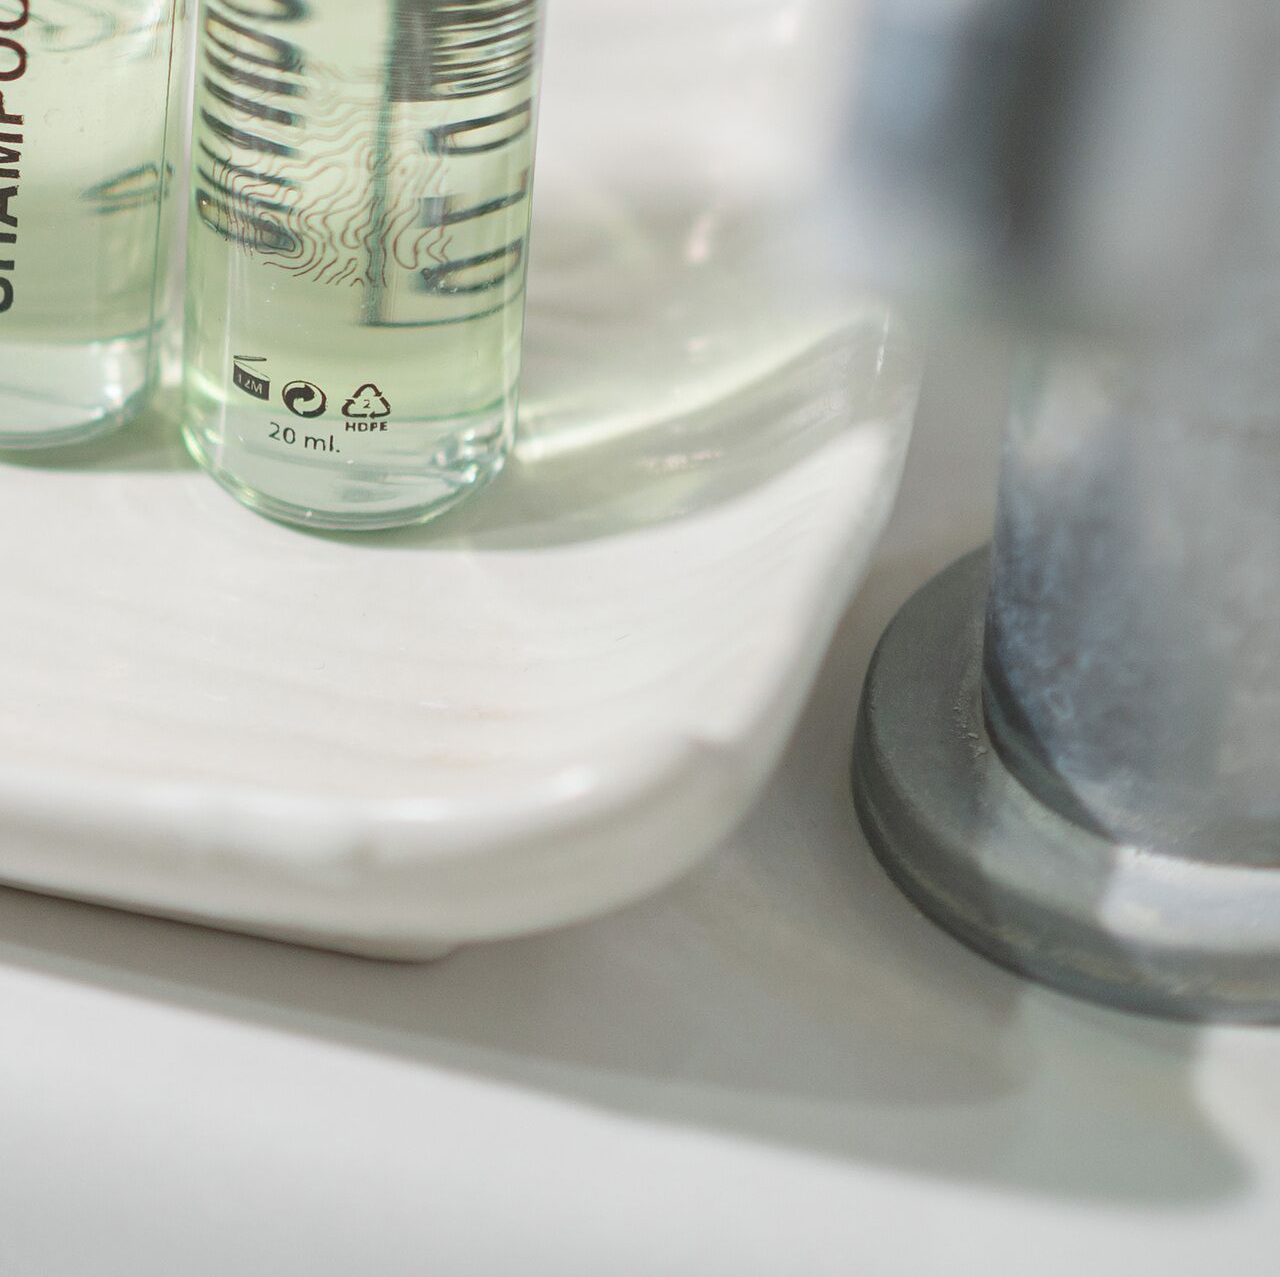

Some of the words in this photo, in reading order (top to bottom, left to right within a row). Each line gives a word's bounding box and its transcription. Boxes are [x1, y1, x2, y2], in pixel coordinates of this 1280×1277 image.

[237, 374, 263, 395] 12M
[268, 421, 296, 444] 20
[304, 434, 341, 453] ml.
[345, 421, 388, 433] HDPE
